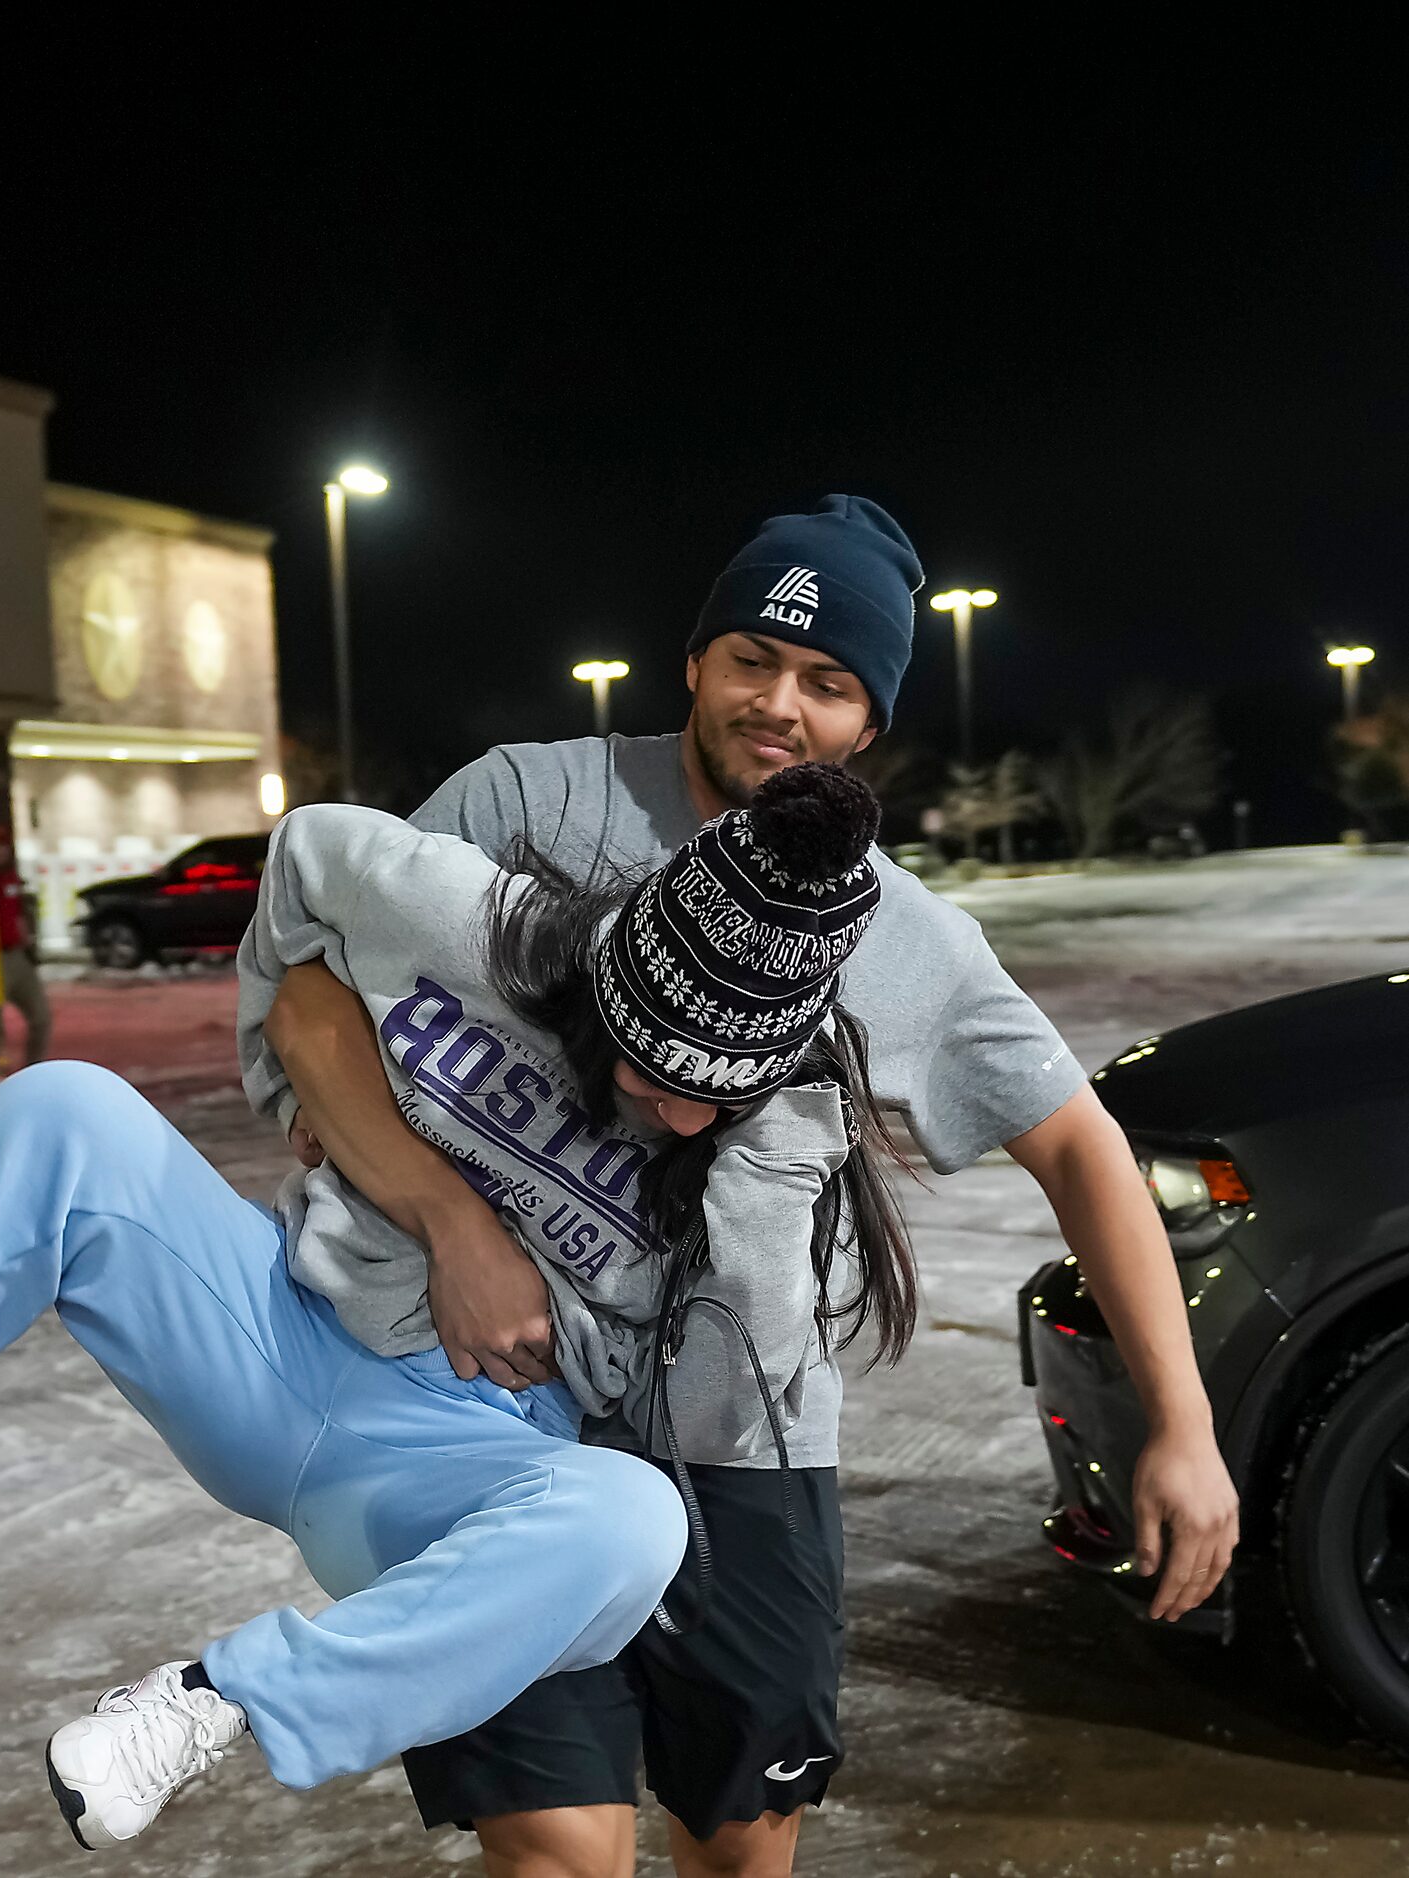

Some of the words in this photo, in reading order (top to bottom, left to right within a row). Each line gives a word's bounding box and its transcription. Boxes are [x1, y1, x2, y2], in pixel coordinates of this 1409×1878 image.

[759, 603, 814, 630] ALDI
[671, 856, 754, 959] TEXAS
[380, 976, 654, 1222] BOSTO
[665, 1039, 777, 1088] TWU
[542, 1203, 618, 1281] USA
